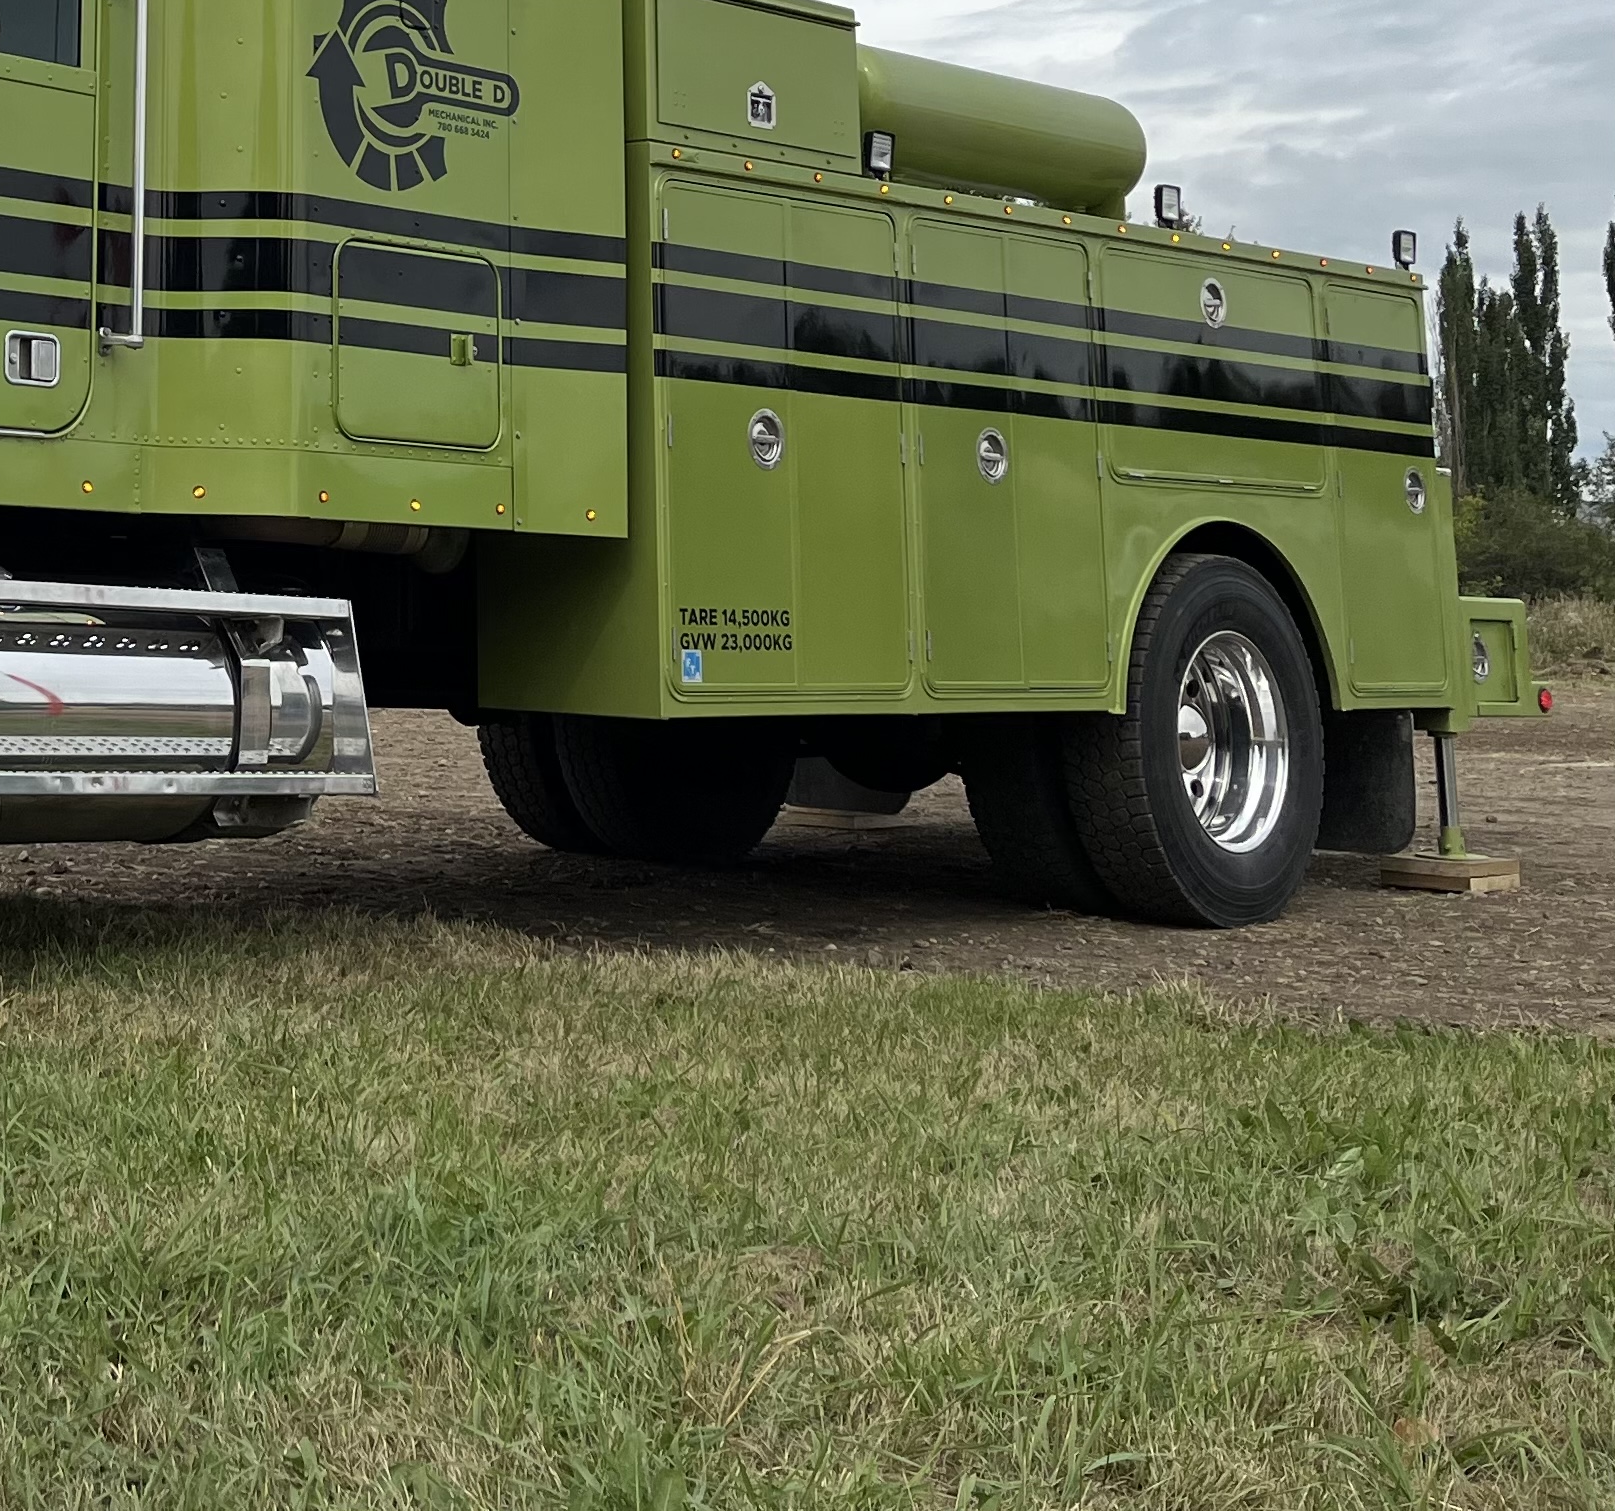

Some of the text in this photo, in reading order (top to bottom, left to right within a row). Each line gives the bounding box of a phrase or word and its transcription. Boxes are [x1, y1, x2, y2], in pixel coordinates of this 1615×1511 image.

[385, 53, 505, 104] DOUBLE D
[428, 108, 499, 130] MECHANICAL INC.
[437, 121, 453, 133] 780
[470, 128, 490, 140] 3424
[679, 608, 790, 629] TARE 14,500KG
[680, 632, 793, 653] GVW 23,000KG
